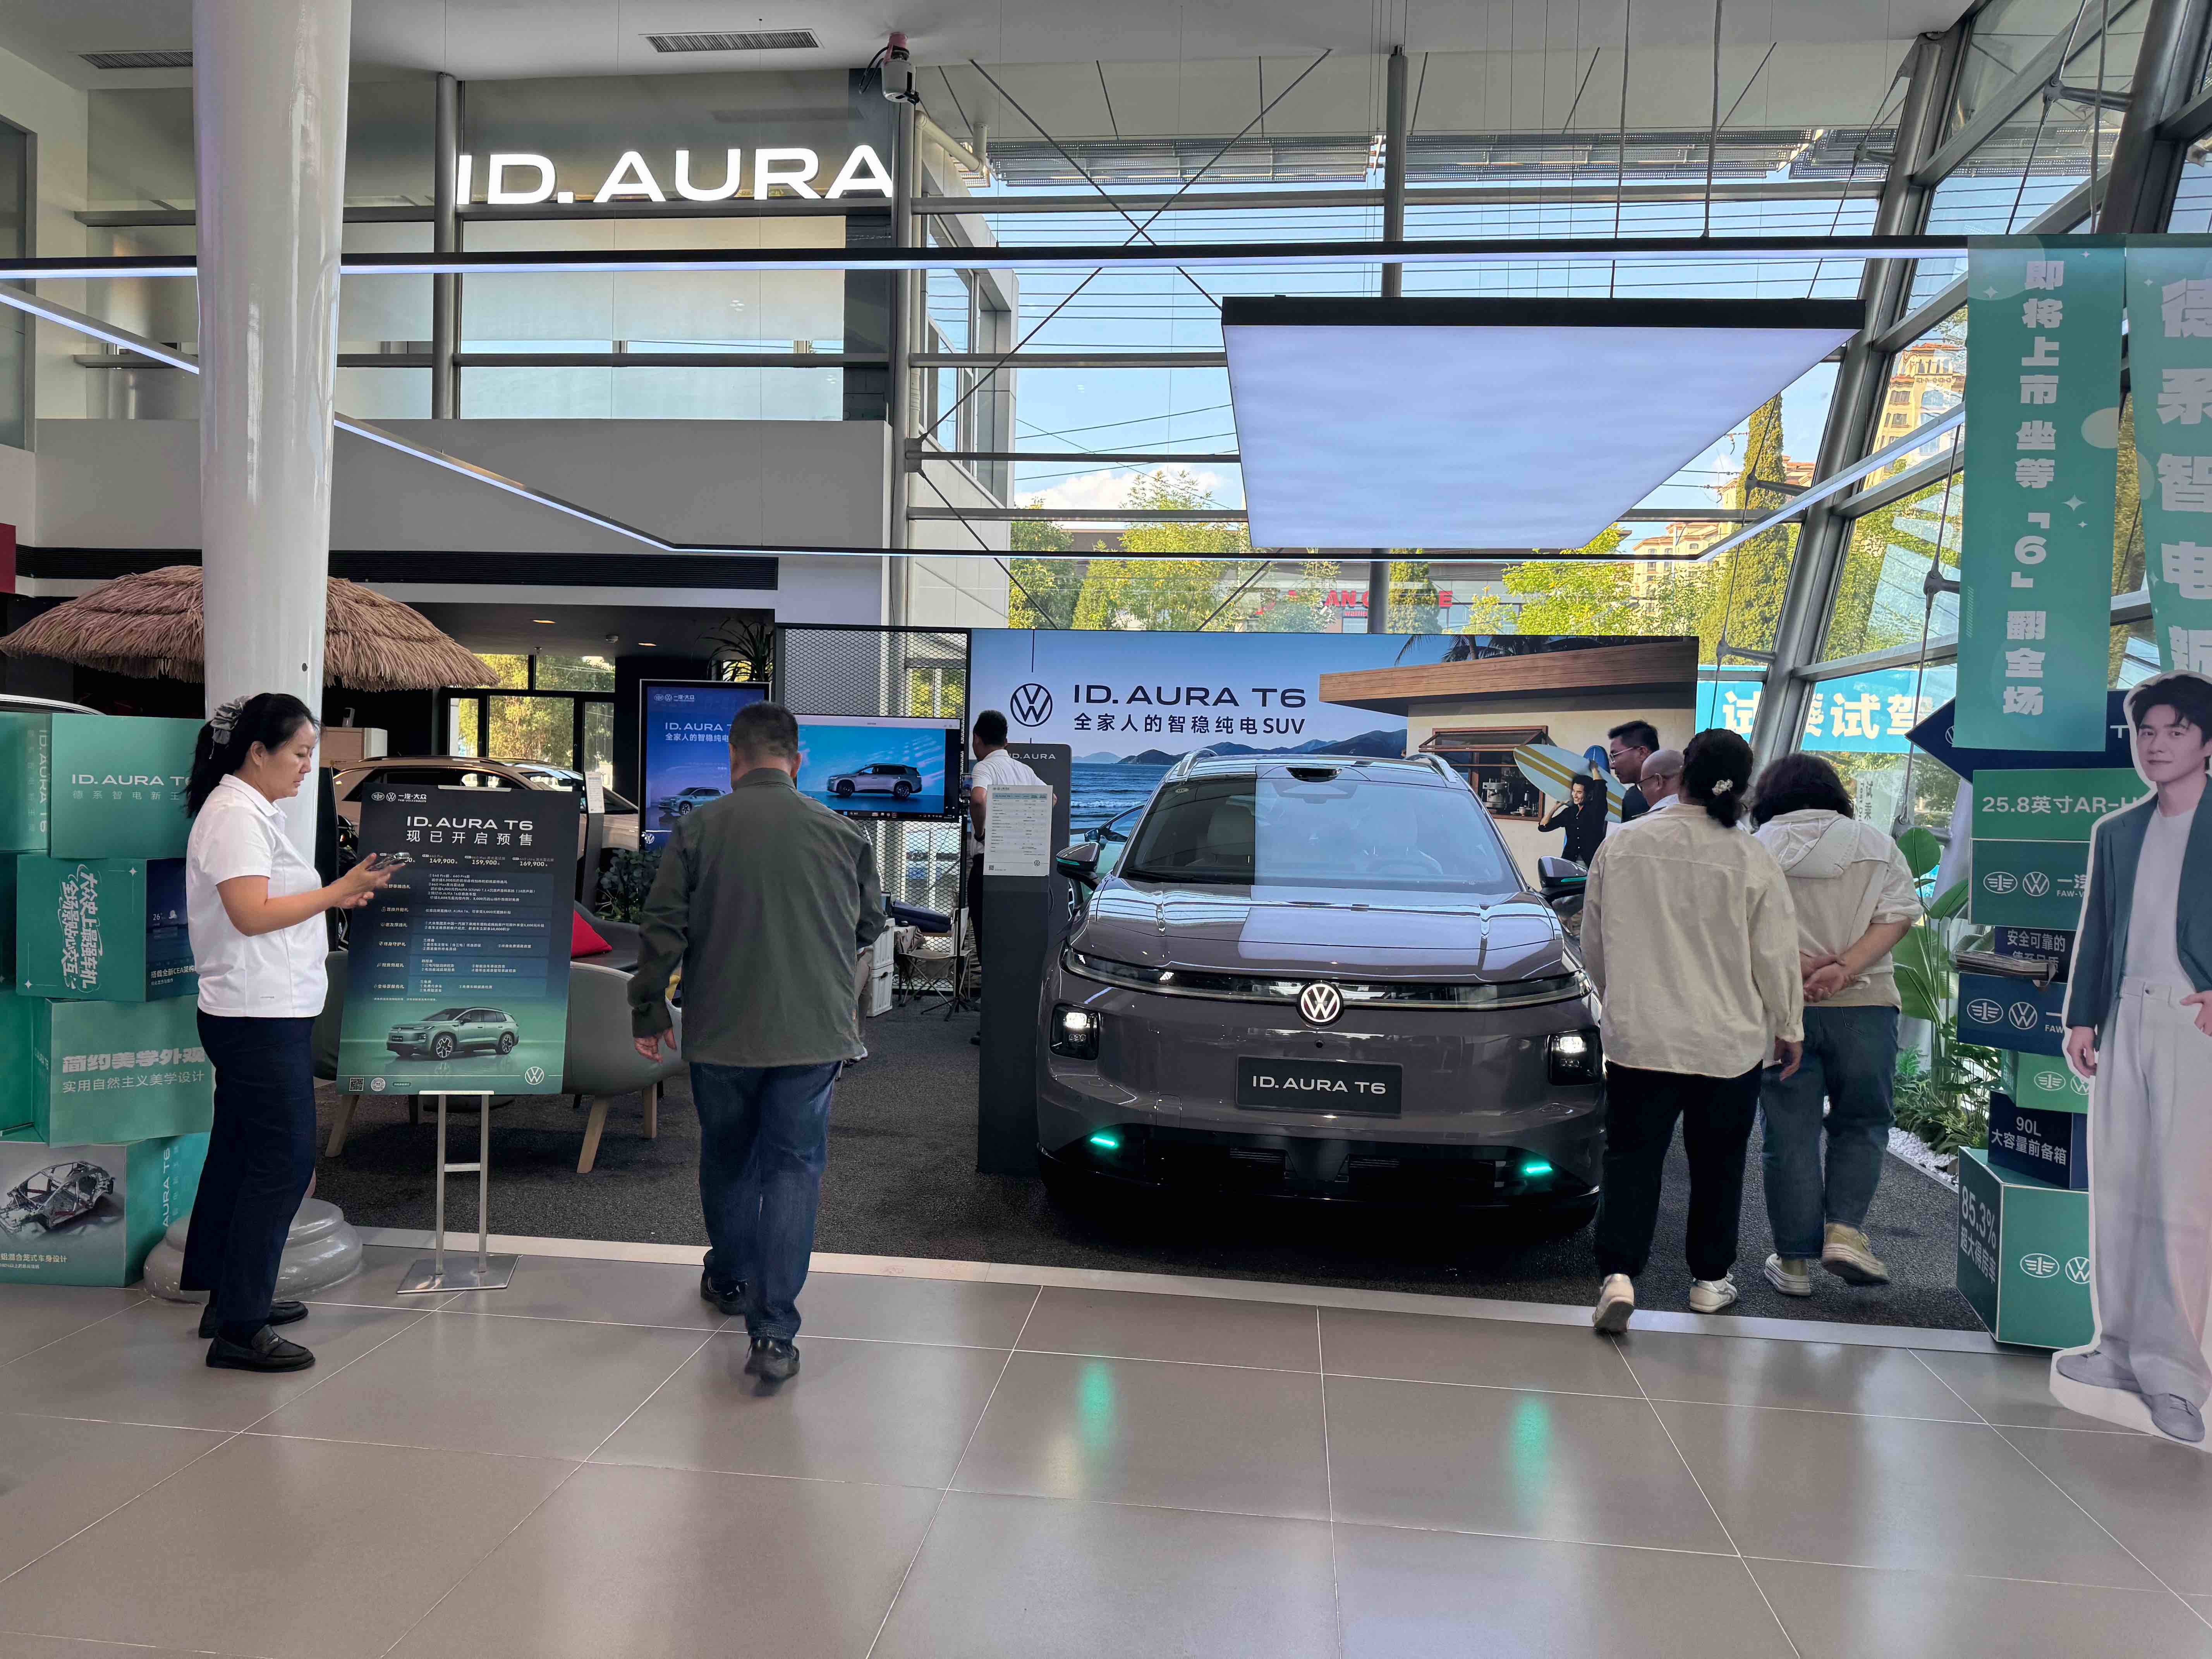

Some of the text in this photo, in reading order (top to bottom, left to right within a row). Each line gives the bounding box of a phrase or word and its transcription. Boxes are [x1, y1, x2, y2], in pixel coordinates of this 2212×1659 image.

[594, 145, 893, 202] AURA
[1126, 685, 1239, 706] AURA
[1252, 688, 1306, 708] T6
[684, 723, 723, 731] AURA
[1074, 712, 1305, 734] 全家人的智稳纯电SUV
[101, 775, 165, 786] AURA
[436, 817, 498, 830] AURA
[504, 820, 533, 831] T6
[406, 830, 533, 846] 现已开启预售
[2007, 929, 2066, 952] 安全可靠的
[62, 1047, 205, 1073] 简约美学外观
[62, 1070, 205, 1093] 实用自然主义美学设计
[1282, 1077, 1348, 1093] AURA
[1355, 1082, 1386, 1094] T6
[2016, 1116, 2042, 1137] 90L
[1991, 1129, 2067, 1165] 大容量前备箱
[163, 1147, 170, 1174] T6
[1962, 1185, 1996, 1249] 85.3%
